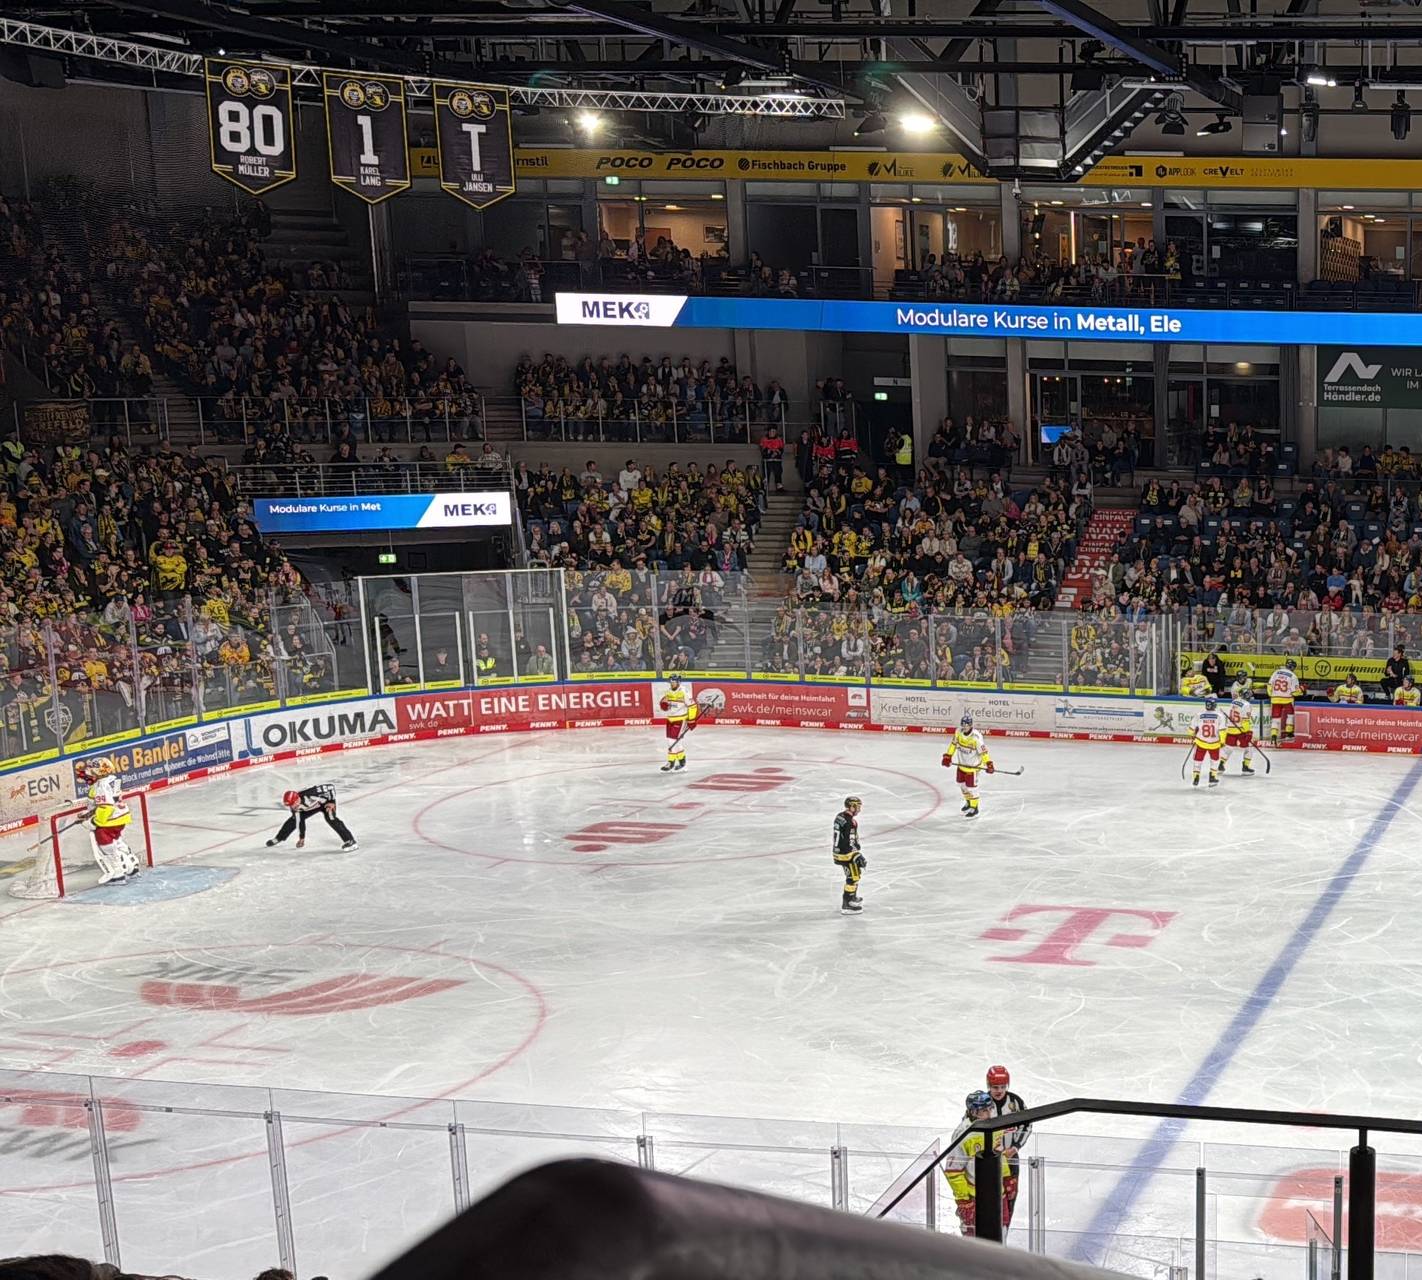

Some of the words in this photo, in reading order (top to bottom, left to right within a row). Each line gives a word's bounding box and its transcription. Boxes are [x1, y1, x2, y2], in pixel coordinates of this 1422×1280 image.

[218, 100, 284, 157] 80
[357, 115, 379, 165] 1
[462, 123, 486, 171] T
[240, 155, 267, 166] ROBERT
[596, 157, 653, 169] POCO
[666, 157, 724, 170] POCO
[751, 159, 804, 171] Fischbach
[808, 160, 847, 173] Gruppe
[238, 164, 270, 178] MÜLLER
[360, 166, 380, 176] KAREL
[471, 172, 484, 181] ULLI
[360, 175, 381, 187] LANG
[463, 181, 493, 193] JANSEN
[897, 308, 988, 328] Modulare
[994, 311, 1048, 329] Kurse
[1053, 311, 1072, 329] in
[1077, 313, 1145, 336] Metall,
[1150, 315, 1182, 333] Ele
[1391, 367, 1412, 377] WIR
[1323, 383, 1382, 393] Terrassendach
[1406, 381, 1419, 390] IM
[1323, 392, 1381, 402] Händler.de
[270, 504, 317, 514] Modulare
[319, 503, 348, 513] Kurse
[349, 503, 359, 512] in
[360, 502, 381, 512] Met
[731, 692, 767, 701] Sicherheit
[768, 692, 779, 701] für
[780, 694, 799, 702] deine
[800, 694, 836, 703] Heimfahrt
[407, 699, 472, 721] WATT
[480, 696, 530, 715] EINE
[538, 690, 640, 711] ENERGIE!
[732, 703, 833, 718] swk.de/meinswcar
[881, 703, 929, 716] Krefelder
[933, 705, 952, 716] Hof
[964, 707, 1012, 719] Krefelder
[1016, 709, 1034, 720] Hof
[1317, 716, 1344, 725] Leichtes
[1346, 718, 1363, 726] Spiel
[263, 708, 396, 748] OKUMA
[1201, 724, 1216, 738] 81
[1317, 730, 1419, 743] swk.de/meinswcar
[132, 736, 186, 769] Bande!
[28, 775, 60, 797] EGN
